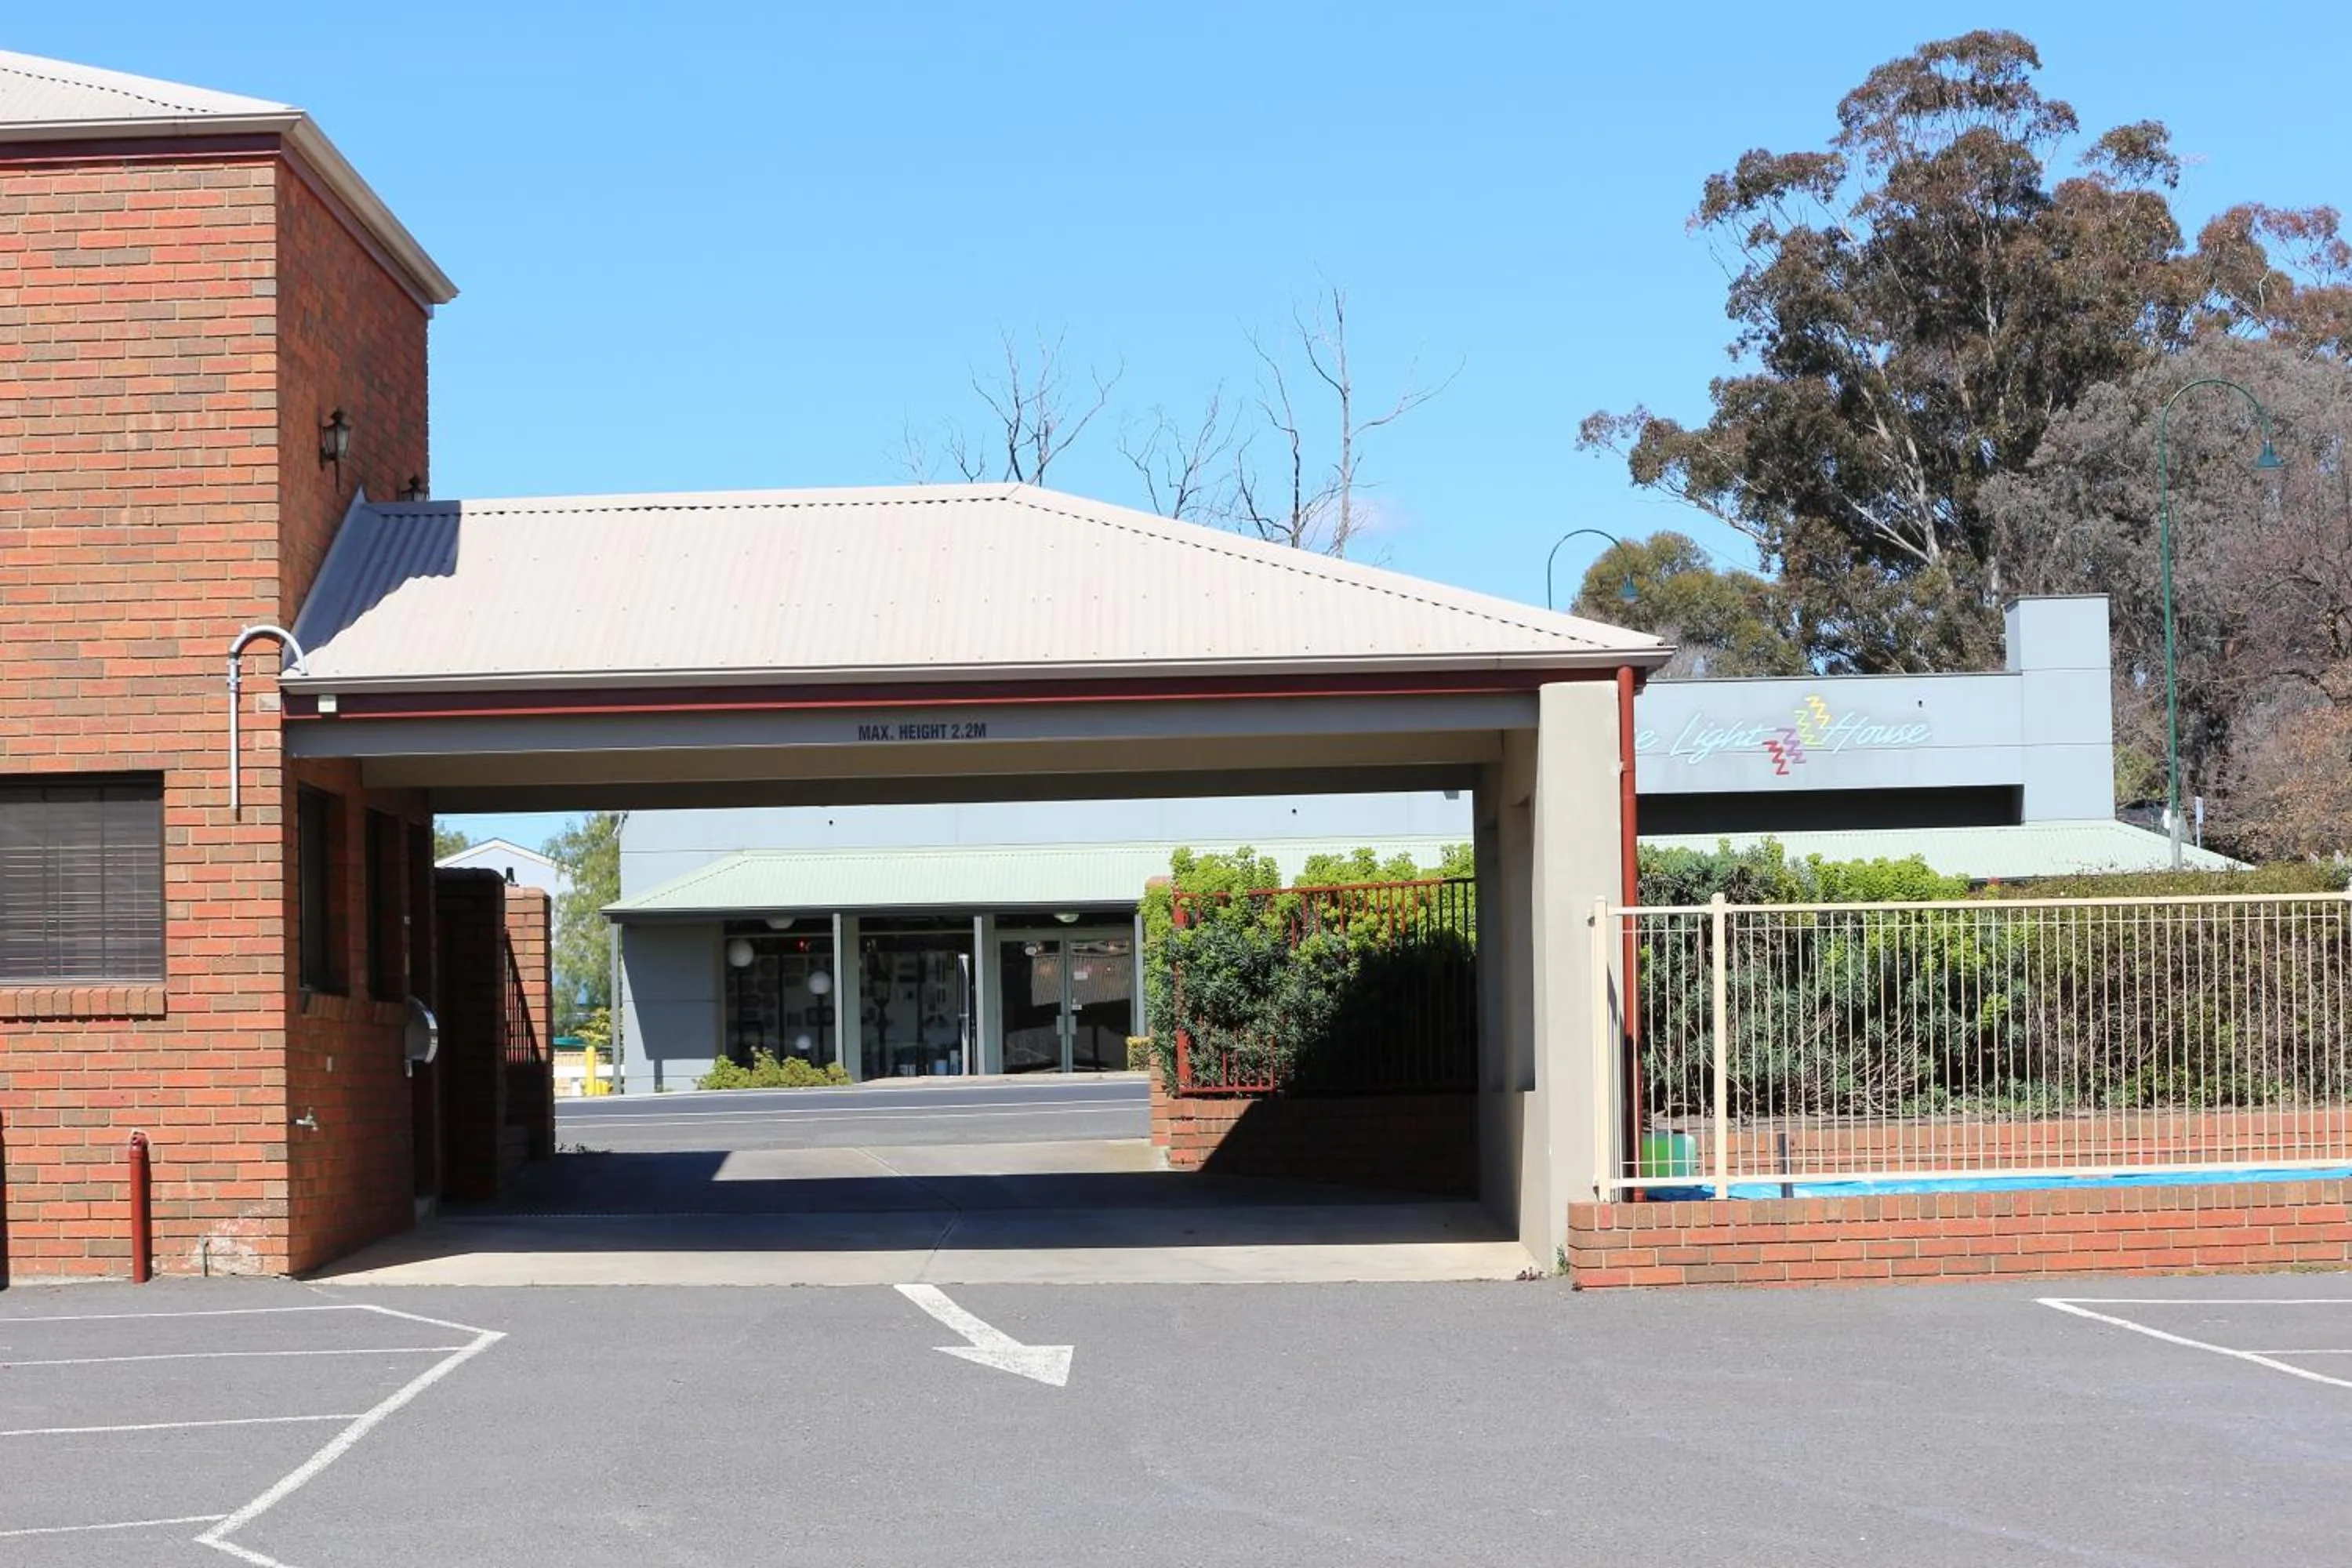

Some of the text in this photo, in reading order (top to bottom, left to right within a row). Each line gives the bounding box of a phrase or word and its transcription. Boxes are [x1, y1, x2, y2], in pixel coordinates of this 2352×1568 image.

[858, 723, 986, 740] MAX. HEIGHT 2.2M
[1669, 712, 1777, 764] Light
[1820, 710, 1933, 754] House
